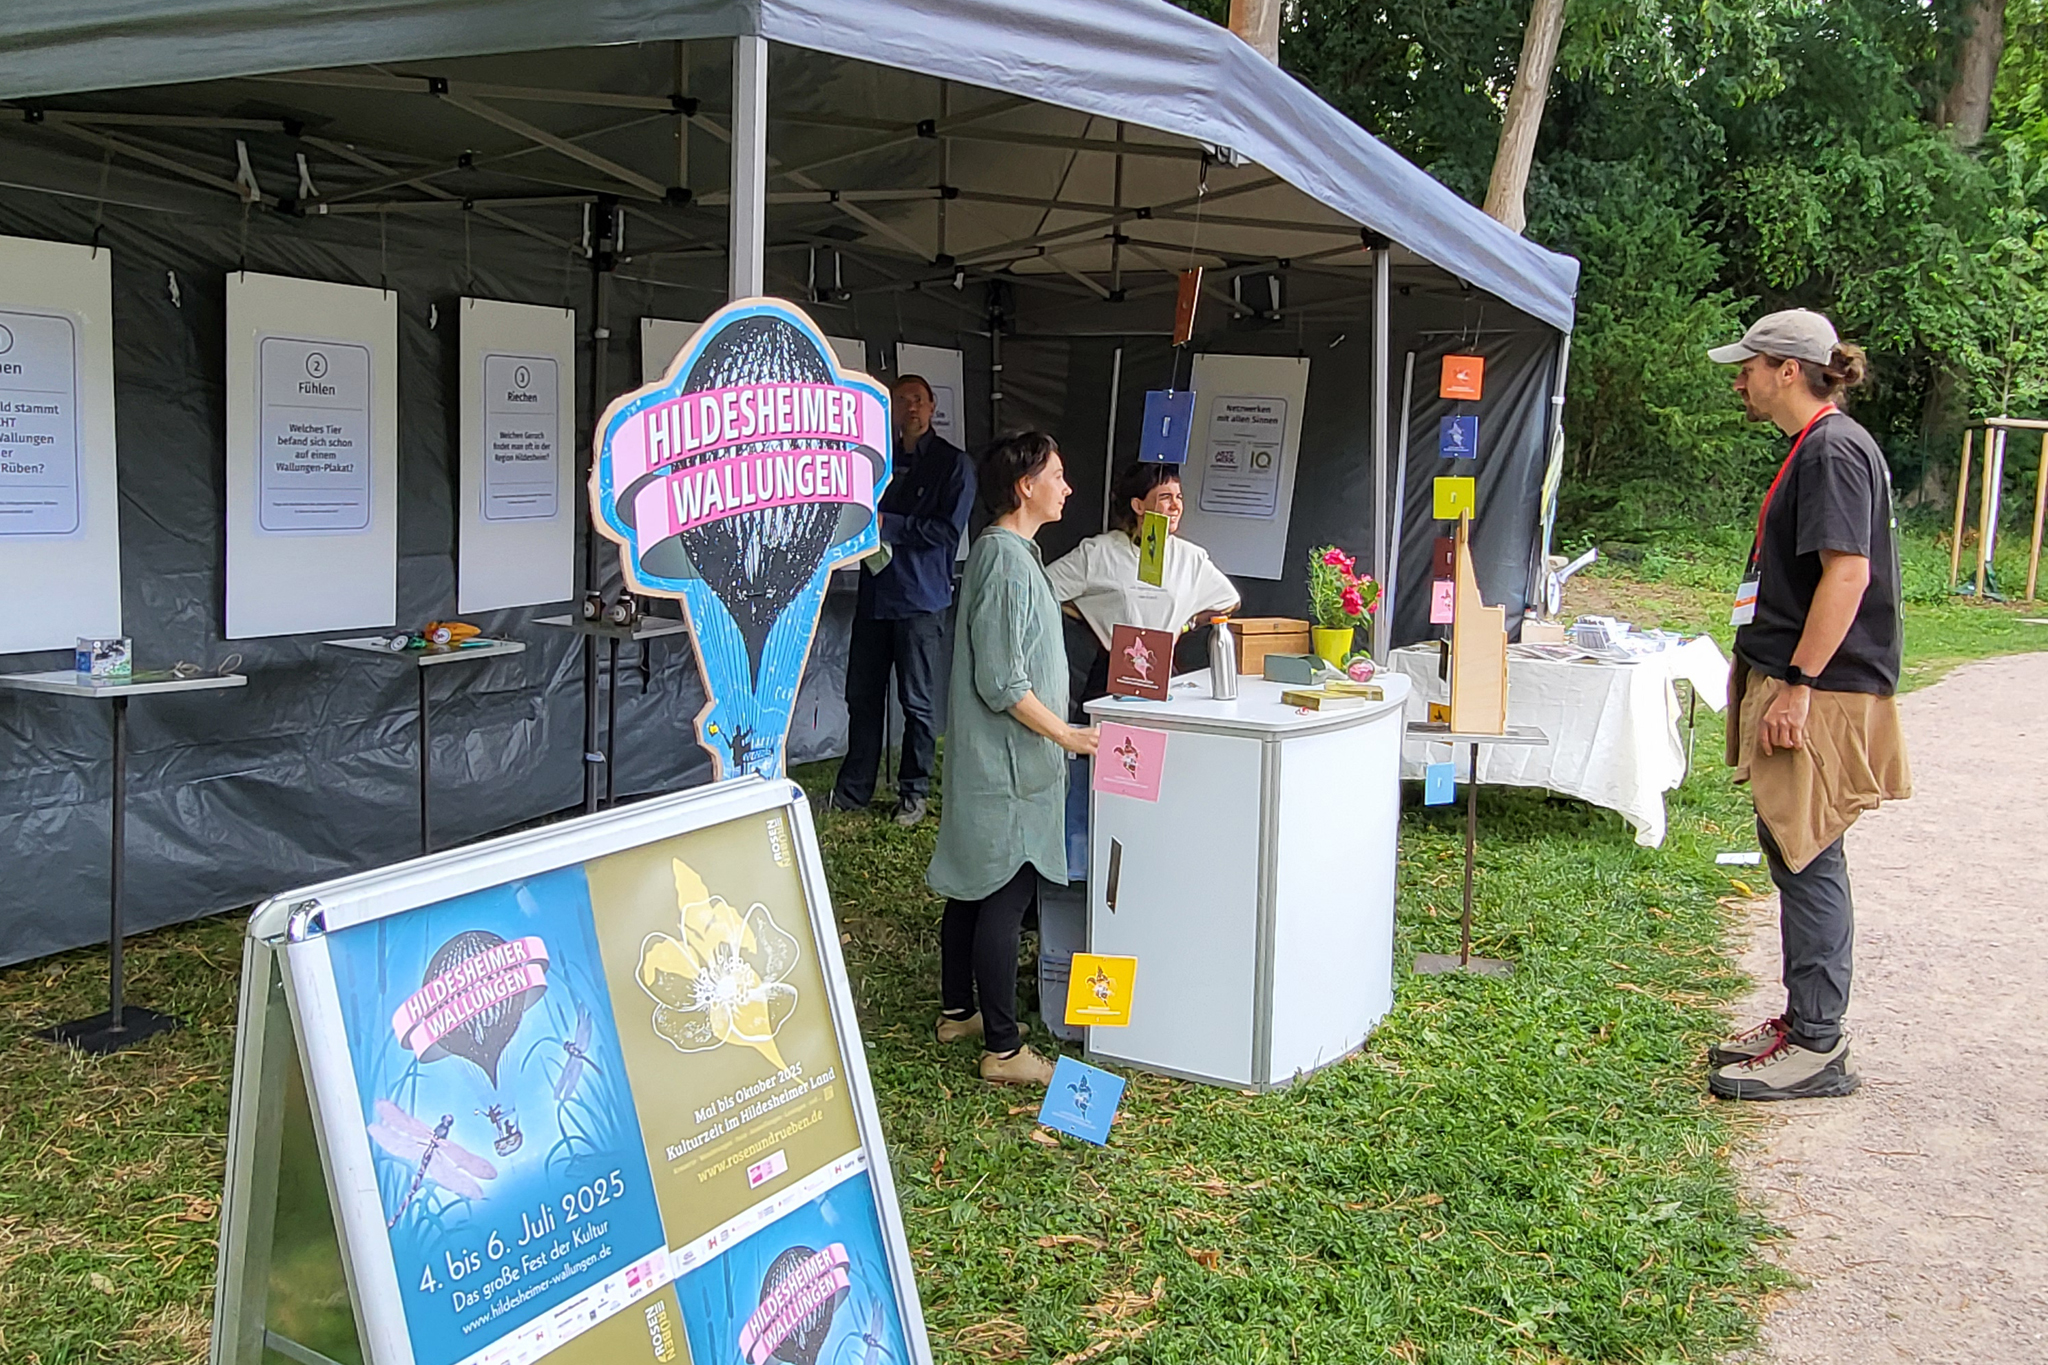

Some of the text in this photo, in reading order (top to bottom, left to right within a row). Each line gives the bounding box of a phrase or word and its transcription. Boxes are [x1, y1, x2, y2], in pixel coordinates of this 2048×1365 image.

[298, 382, 336, 396] Fühlen
[313, 360, 321, 372] 2
[14, 404, 60, 415] stammt
[507, 391, 538, 402] Riechen
[278, 436, 353, 447] befand sich schon
[289, 424, 342, 434] Welches Tier
[648, 386, 861, 466] HILDESHEIMER
[1, 462, 45, 474] Rüben?
[276, 462, 354, 473] Wallungen-Plakat?
[295, 450, 337, 460] auf einem
[671, 454, 849, 526] WALLUNGEN
[766, 819, 782, 861] ROSEN
[407, 941, 527, 1021] HILDESHEIMER
[426, 968, 529, 1037] WALLUNGEN
[717, 1096, 735, 1113] bis
[735, 1075, 777, 1104] Oktober
[778, 1061, 803, 1084] 2025
[665, 1122, 724, 1162] Kulturzeit
[725, 1115, 740, 1132] im
[740, 1081, 809, 1125] Hildesheimer
[809, 1066, 836, 1091] Land
[696, 1108, 824, 1183] www.rosenundrueben.de
[418, 1169, 626, 1294] 4. bis 6. Juli 2025
[452, 1220, 609, 1313] Das große Fest der Kultur
[462, 1242, 613, 1336] www.hildesheimer-wallungen.de
[748, 1248, 834, 1338] HILDESHEIMER
[763, 1274, 837, 1349] WALLUNGEN
[645, 1305, 665, 1357] ROSEN
